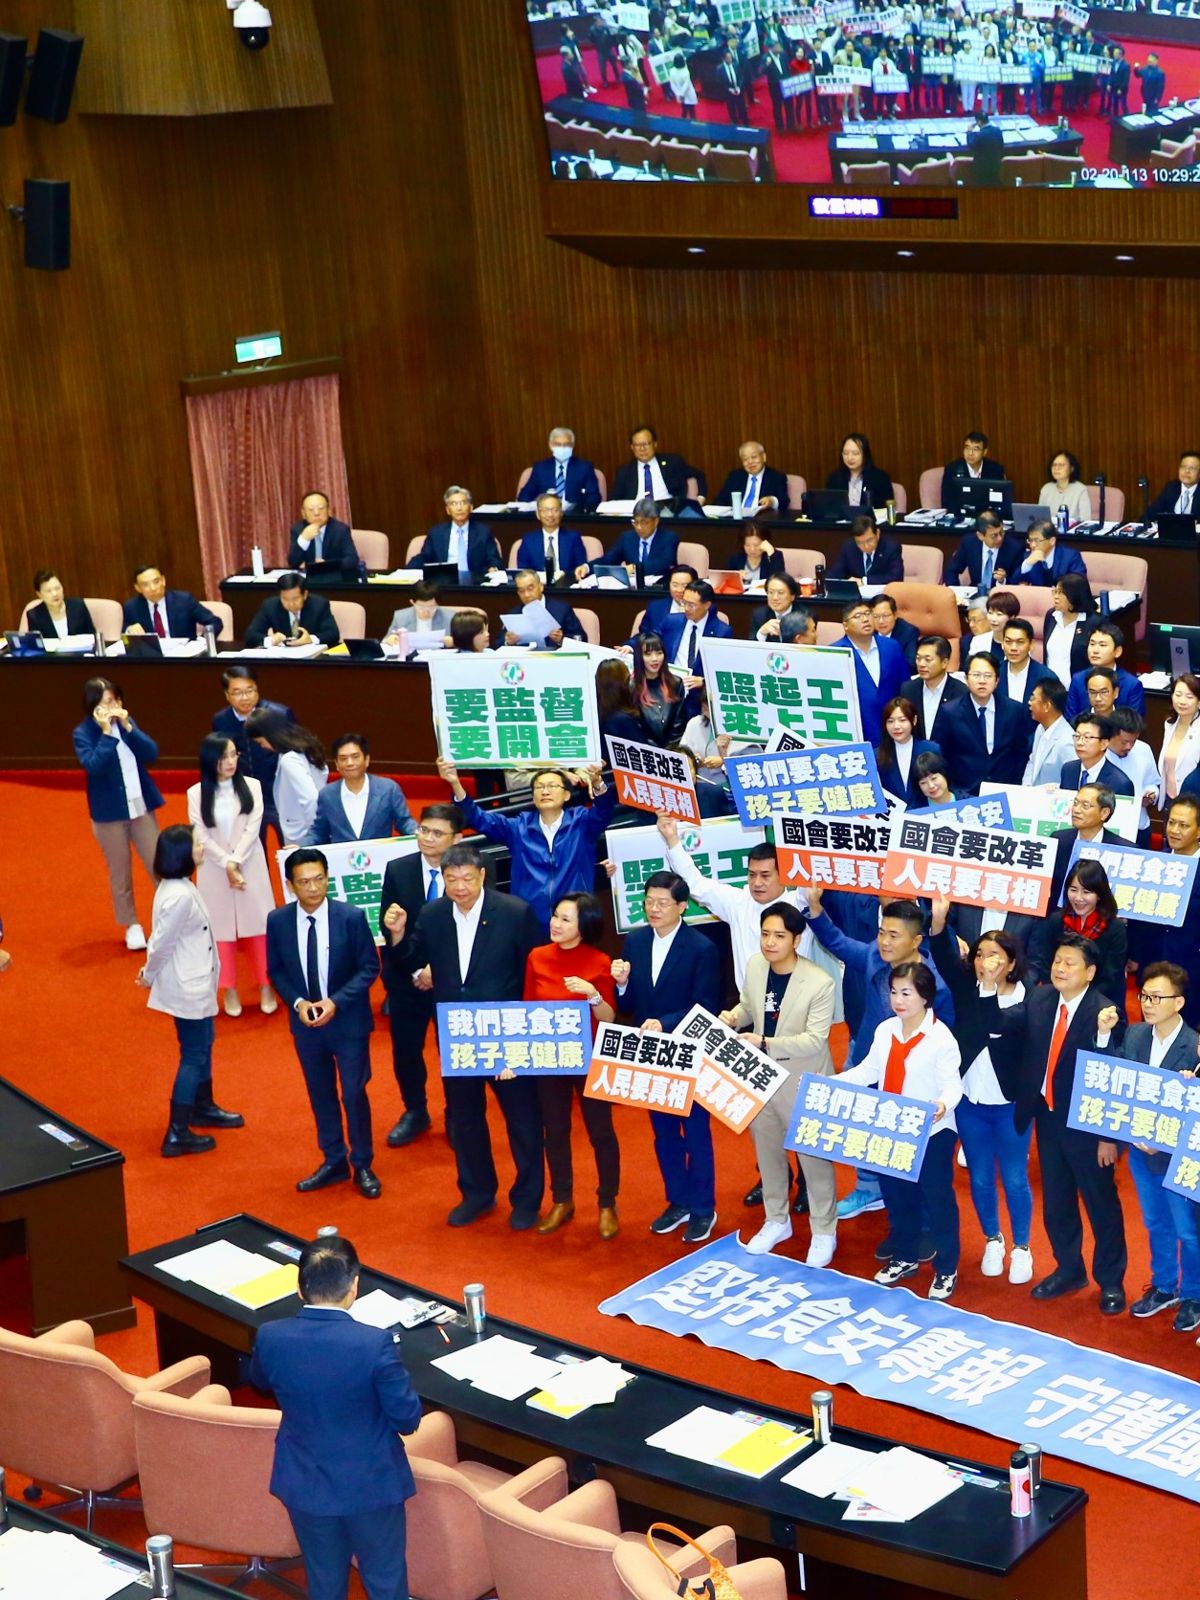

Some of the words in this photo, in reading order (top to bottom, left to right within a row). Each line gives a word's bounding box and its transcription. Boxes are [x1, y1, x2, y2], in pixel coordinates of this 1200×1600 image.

[443, 686, 585, 724] 要監督
[715, 670, 849, 710] 照起工
[448, 723, 589, 760] 要開會
[611, 741, 688, 784] 國會要改革
[735, 751, 868, 790] 我們要食安
[621, 776, 697, 819] 人民要真相
[744, 782, 878, 821] 孩子要健康
[899, 819, 1047, 870] 國會要改革
[787, 853, 885, 890] 人民要真
[892, 857, 1042, 910] 人民要真相
[448, 1007, 582, 1037] 我們要食安
[450, 1041, 584, 1070] 孩子要健康
[599, 1028, 697, 1072] 國會要改革
[682, 1012, 779, 1092] 國會要改革
[591, 1064, 690, 1112] 人民要真相
[805, 1081, 927, 1138] 我們要食安
[1078, 1094, 1185, 1148] 孩子要健
[794, 1116, 918, 1174] 孩子要健康
